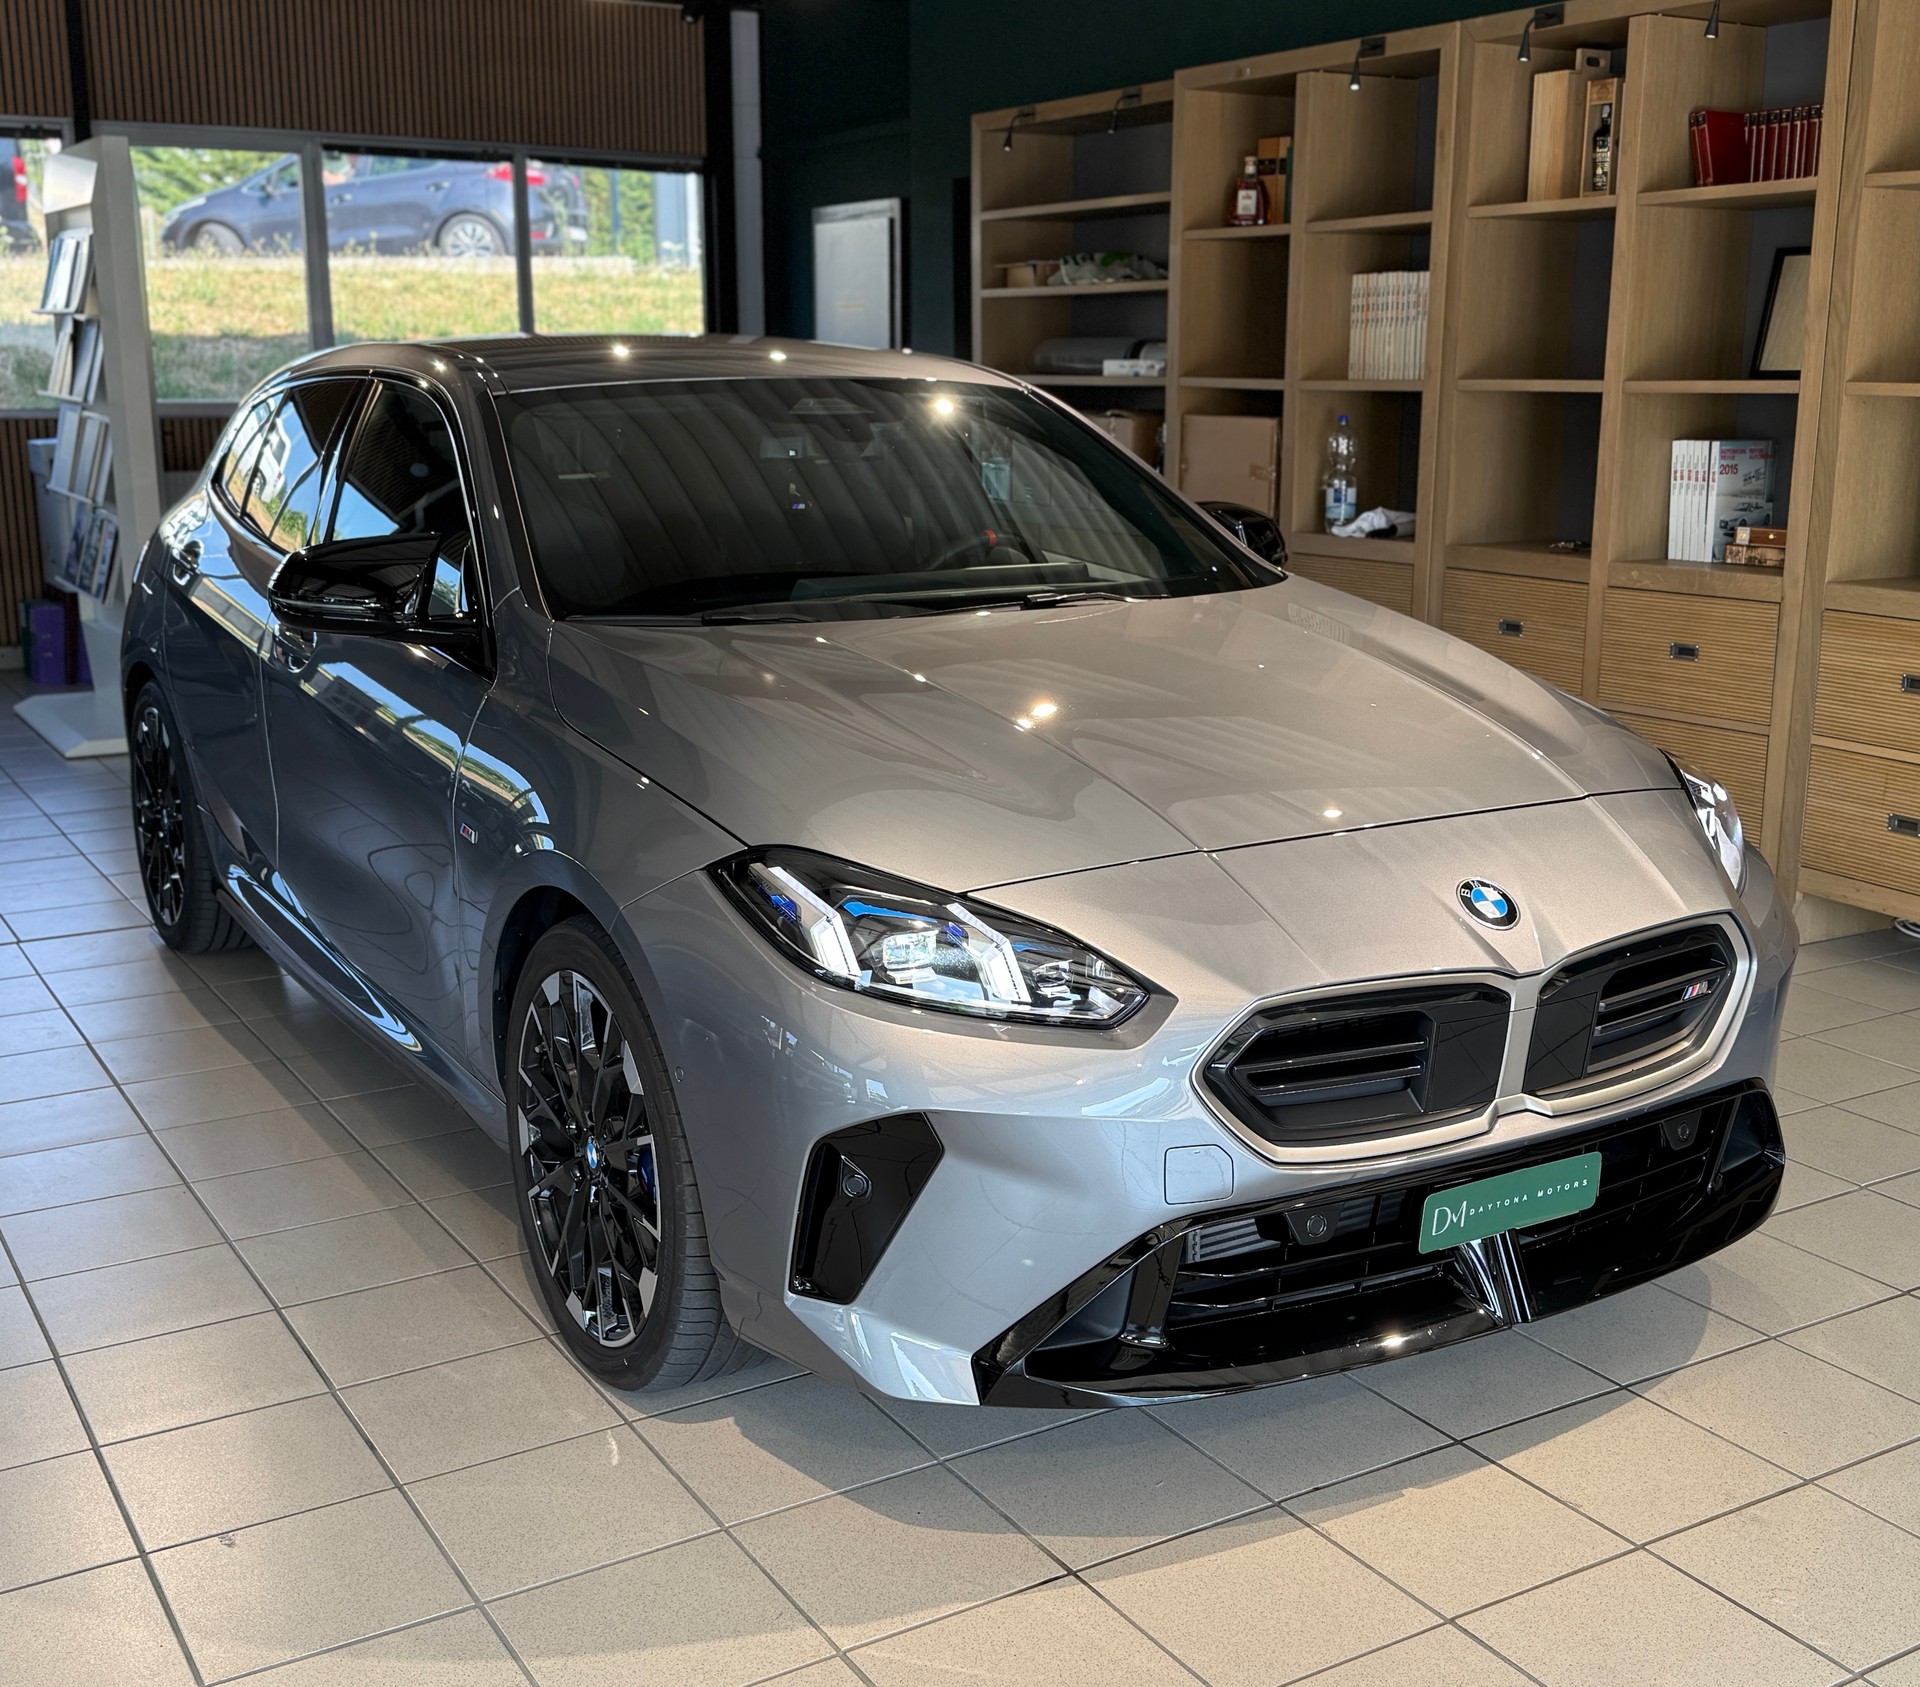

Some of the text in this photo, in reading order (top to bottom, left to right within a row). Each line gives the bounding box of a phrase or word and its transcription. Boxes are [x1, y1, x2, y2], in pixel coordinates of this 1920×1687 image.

[1720, 463, 1739, 475] 2015
[1469, 1194, 1529, 1216] DAYTONA
[1537, 1179, 1588, 1198] MOTORS
